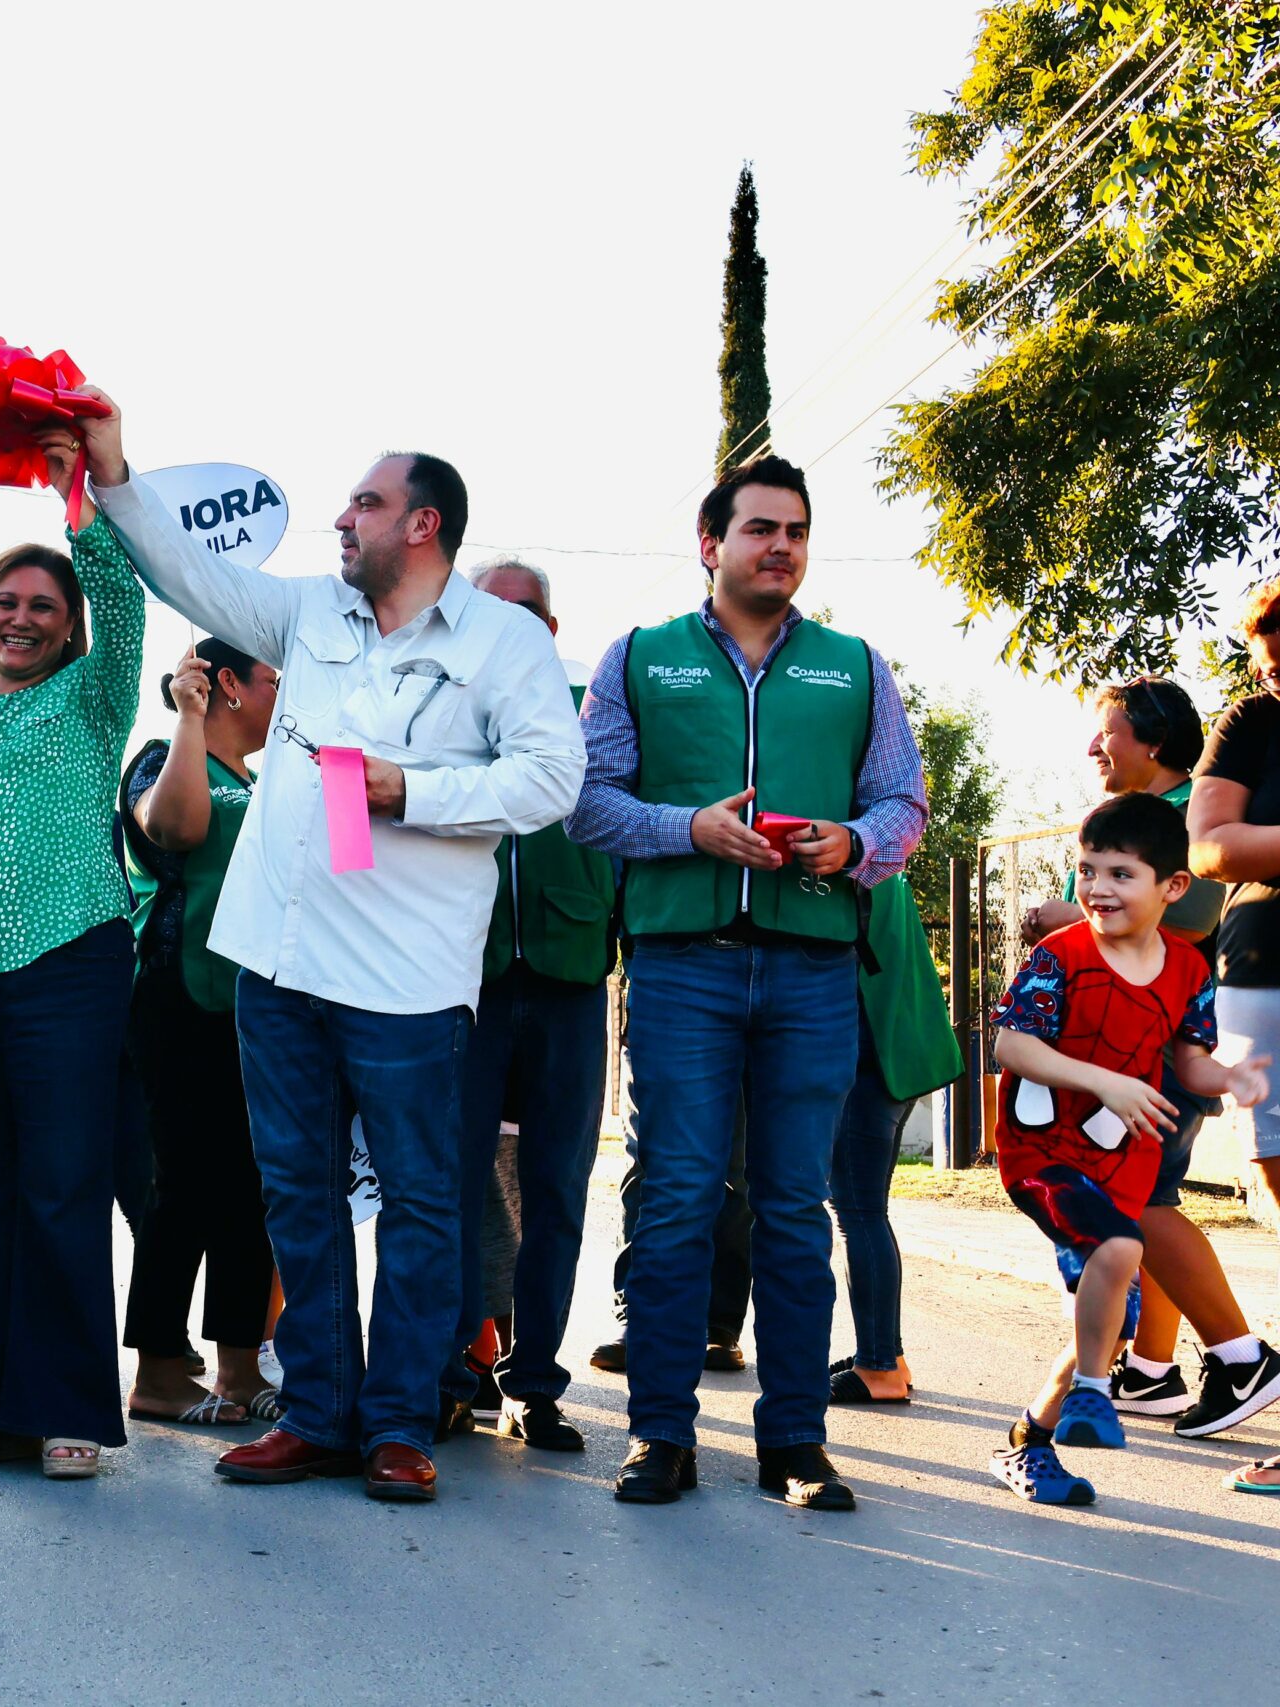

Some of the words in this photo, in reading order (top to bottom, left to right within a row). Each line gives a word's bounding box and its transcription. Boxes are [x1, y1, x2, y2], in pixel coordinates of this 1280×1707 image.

[648, 665, 712, 678] MEJORA
[786, 665, 852, 681] COAHUILA
[660, 676, 703, 685] COAHUILA
